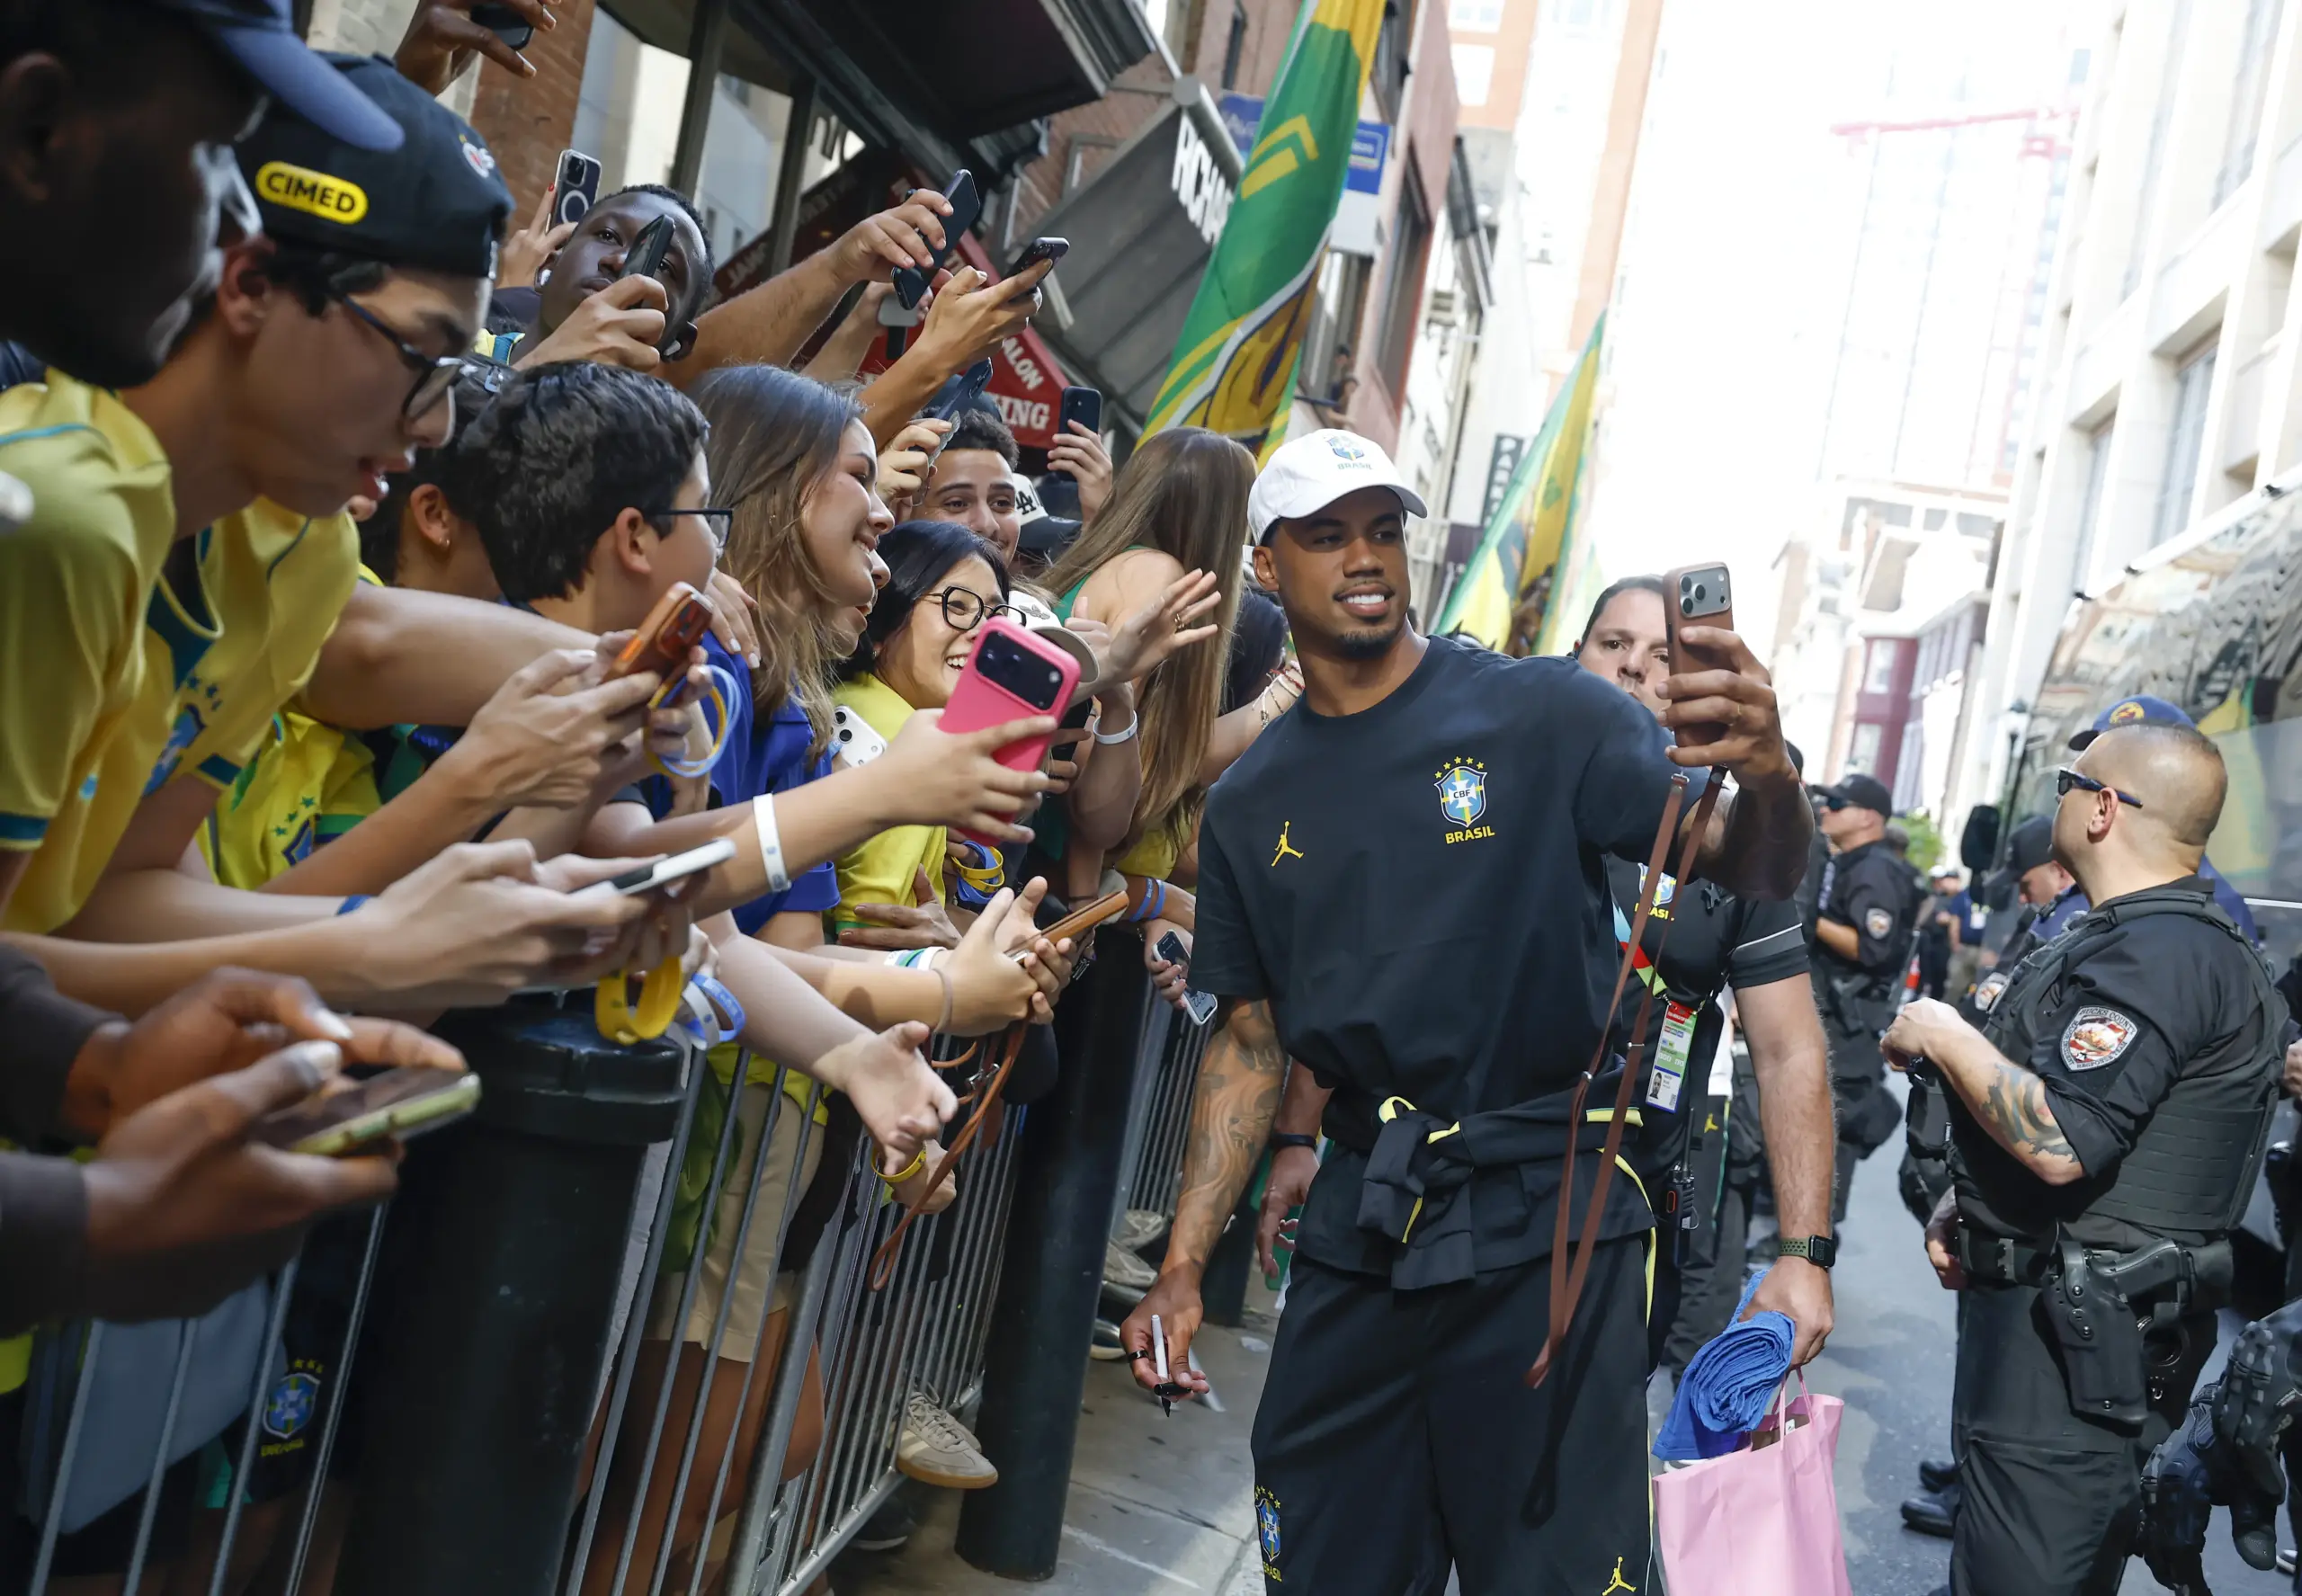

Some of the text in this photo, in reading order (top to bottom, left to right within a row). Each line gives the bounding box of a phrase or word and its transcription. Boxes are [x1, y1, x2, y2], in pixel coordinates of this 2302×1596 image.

[267, 172, 355, 212] CIMED
[1003, 336, 1044, 390] ALON
[1453, 789, 1471, 799] CBF
[1445, 825, 1495, 844] BRASIL
[2109, 1012, 2137, 1035] COUNTY
